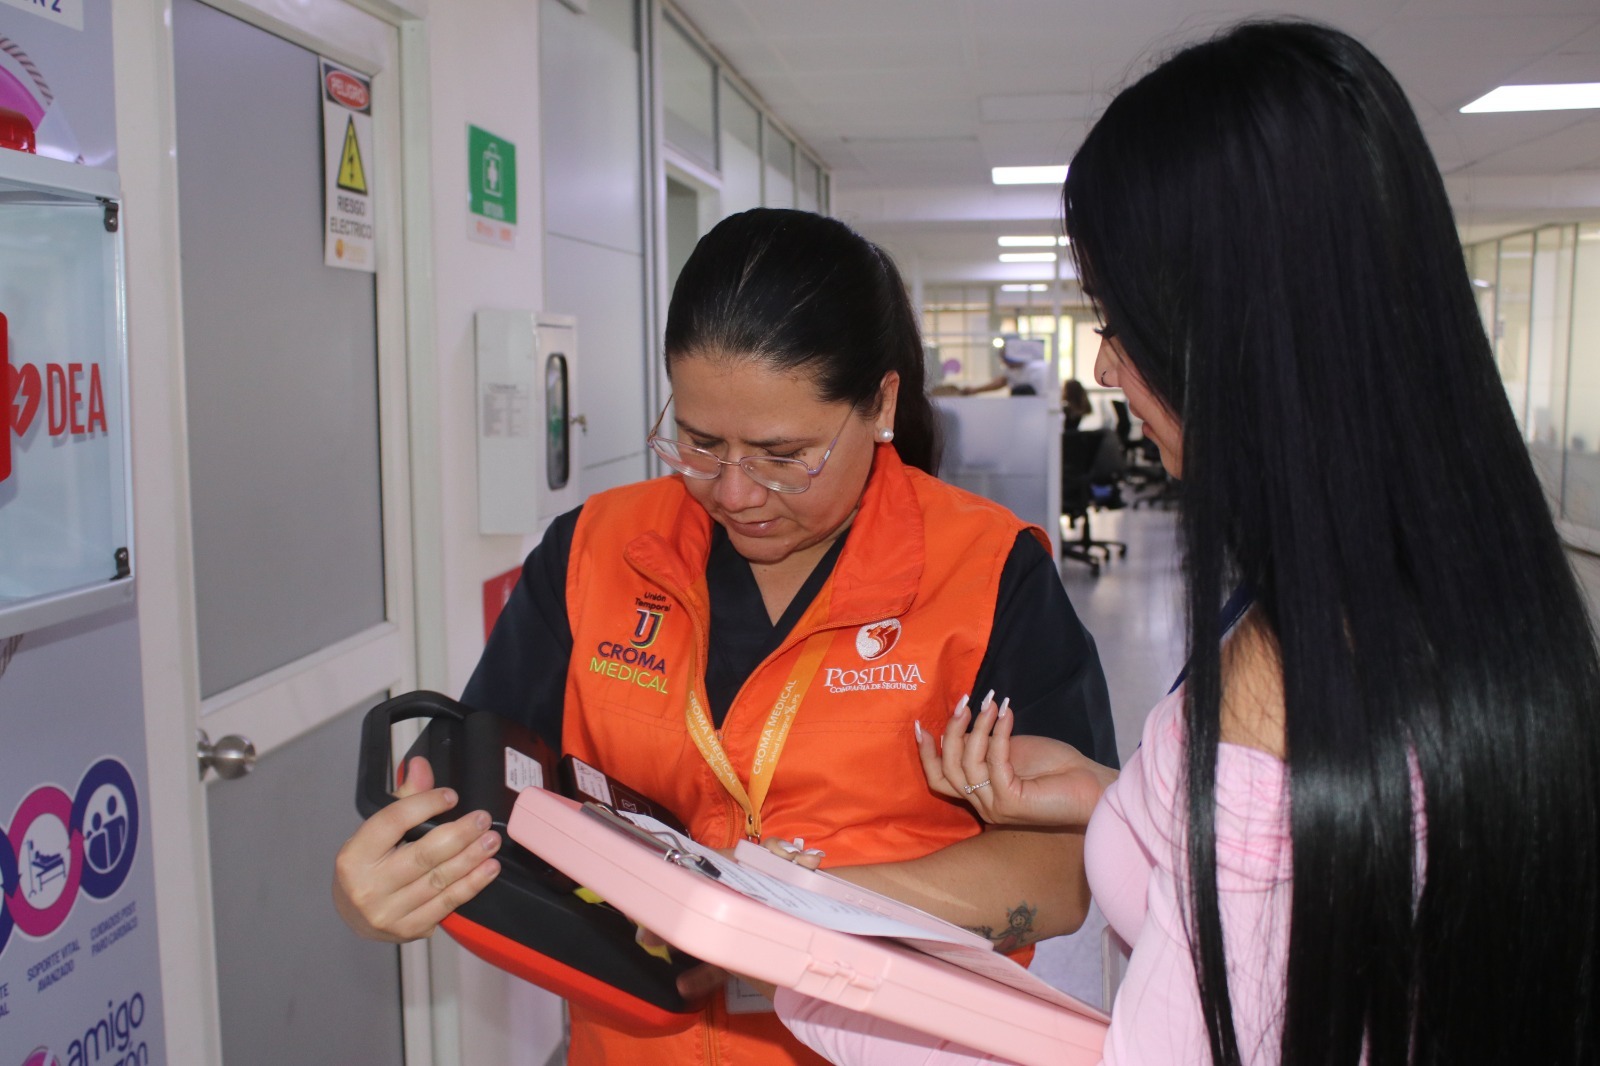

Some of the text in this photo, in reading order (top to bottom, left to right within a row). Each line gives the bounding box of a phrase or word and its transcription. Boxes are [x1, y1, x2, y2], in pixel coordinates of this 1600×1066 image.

[330, 76, 365, 104] PELIGRO
[336, 195, 365, 216] RIESGO
[330, 216, 372, 239] ELECTRICO
[46, 362, 108, 436] DEA
[635, 597, 672, 612] Temporal
[644, 591, 666, 602] Unión
[598, 641, 666, 675] CROMA
[824, 663, 926, 687] POSITIVA
[589, 657, 668, 694] MEDICAL
[689, 690, 737, 786] CROMA MEDICAL
[753, 680, 797, 775] CROMA MEDICAL
[778, 715, 791, 743] Integral
[27, 939, 81, 981] SOPORTE VITAL
[37, 959, 75, 993] AVANZADO
[67, 991, 145, 1066] amigo
